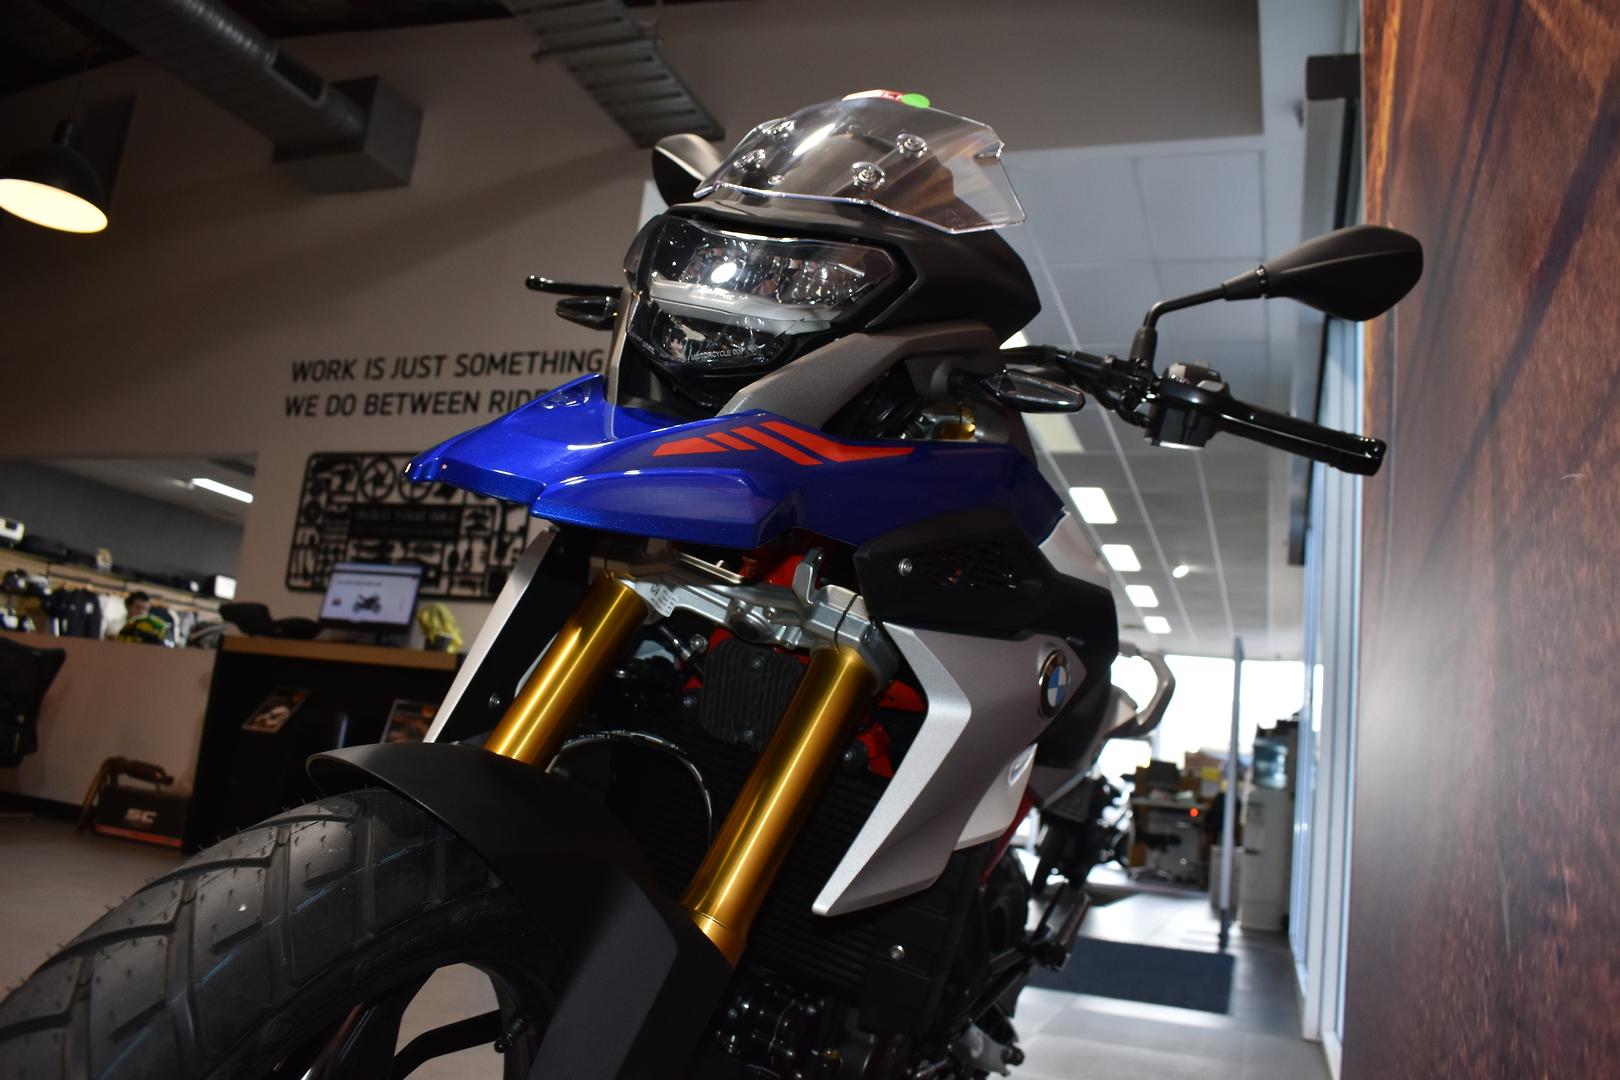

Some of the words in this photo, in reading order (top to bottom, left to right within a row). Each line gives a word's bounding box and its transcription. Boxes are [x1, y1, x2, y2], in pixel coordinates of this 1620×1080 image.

[291, 358, 357, 383] WORK
[363, 356, 385, 380] IS
[390, 354, 448, 379] JUST
[454, 349, 605, 378] SOMETHING
[285, 394, 317, 417] WE
[324, 393, 357, 417] DO
[363, 391, 480, 416] BETWEEN
